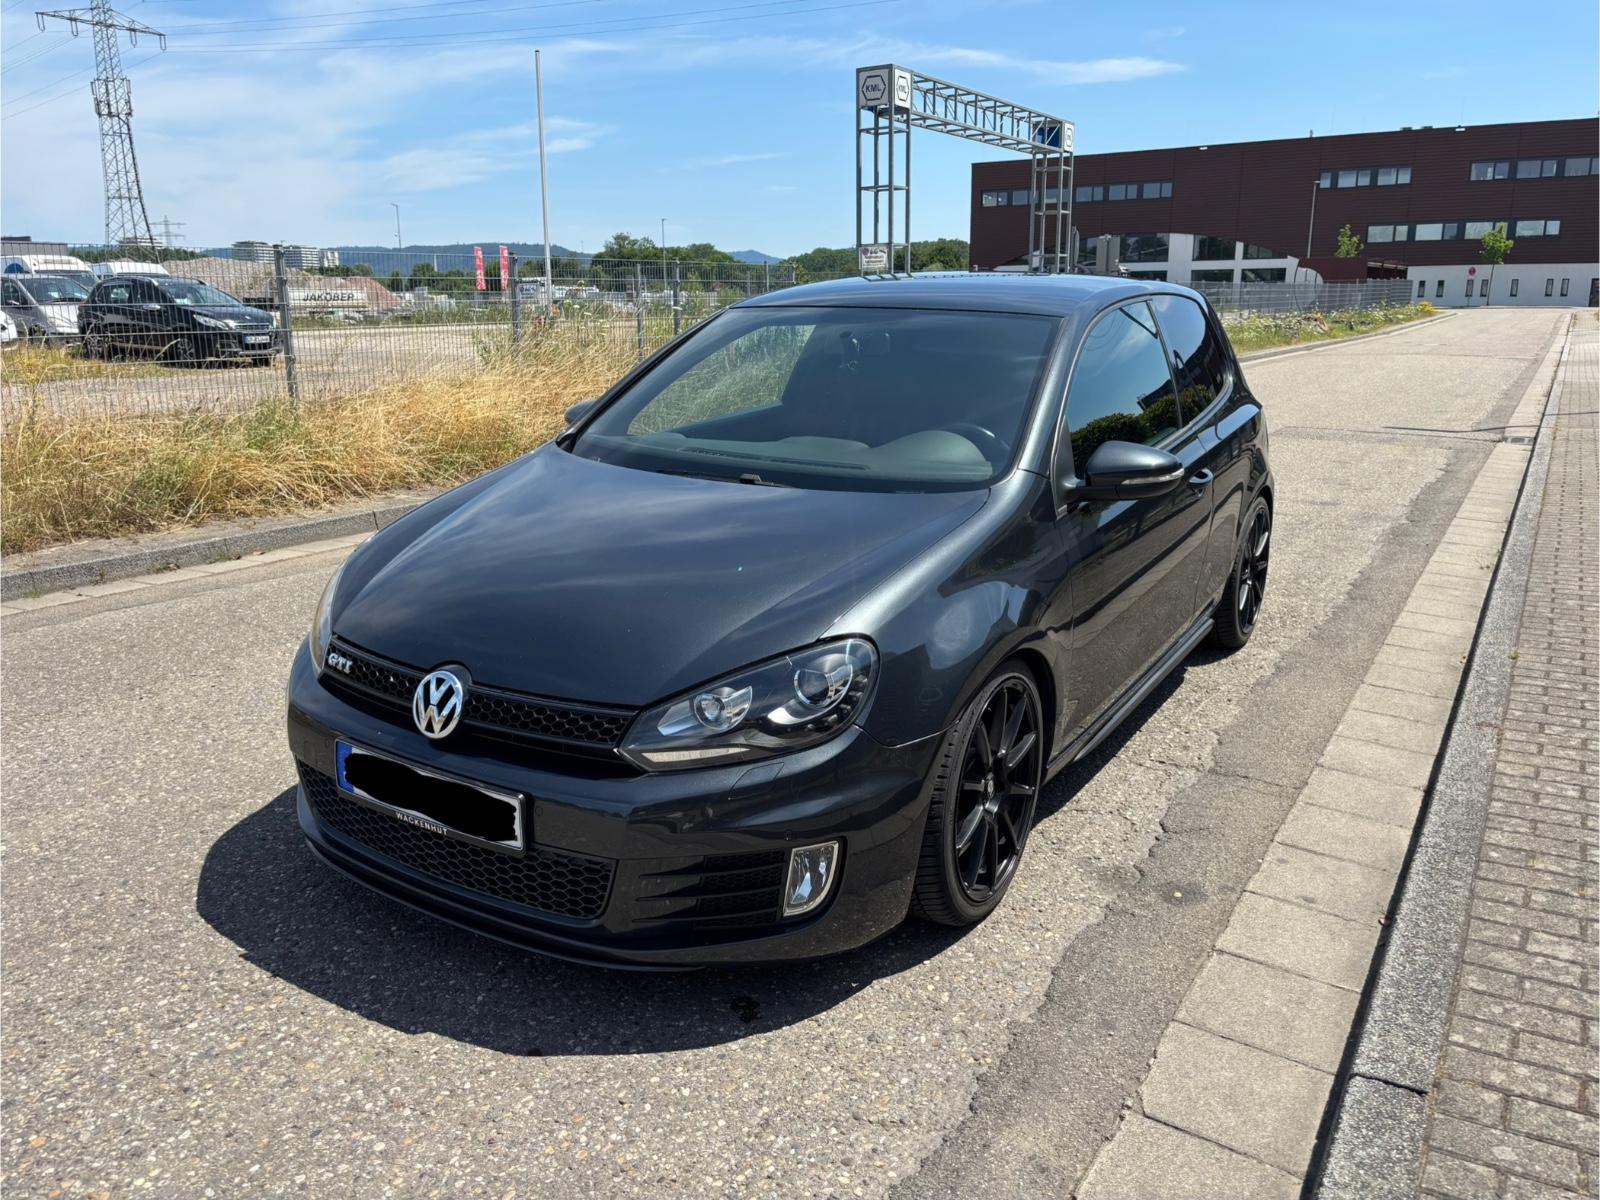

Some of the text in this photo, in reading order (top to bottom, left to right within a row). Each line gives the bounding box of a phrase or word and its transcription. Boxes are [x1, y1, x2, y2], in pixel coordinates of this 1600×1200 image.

[865, 83, 882, 92] KML
[327, 652, 353, 674] GTI
[415, 671, 462, 738] VW
[395, 811, 447, 836] WACKENHUT
